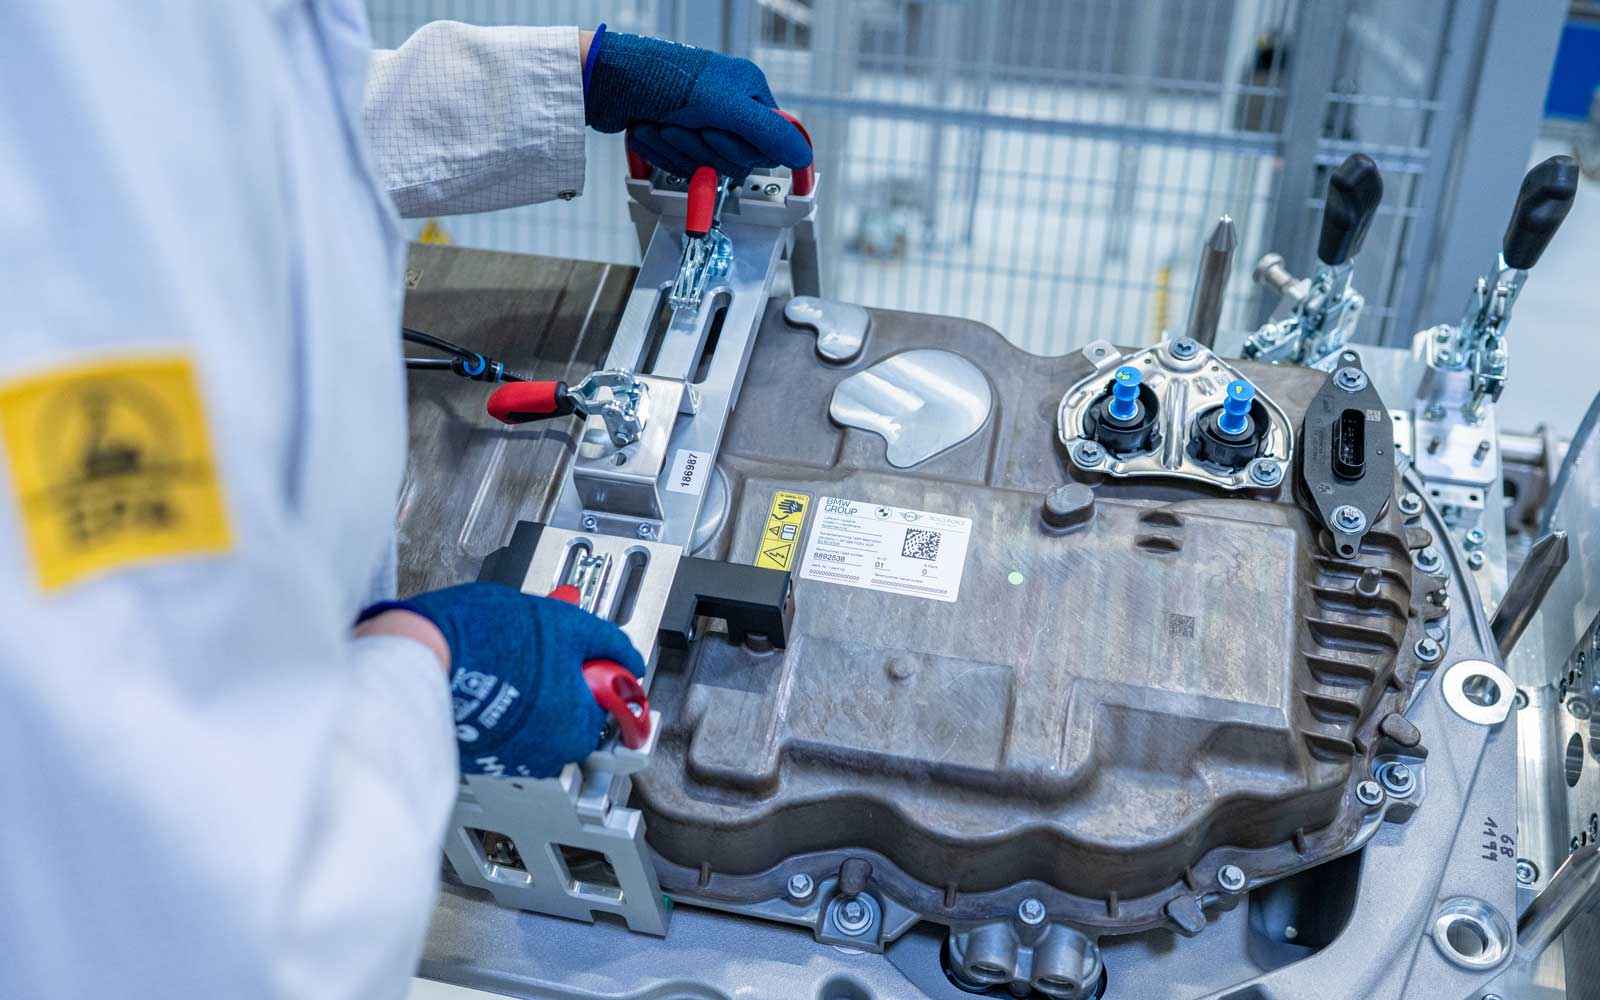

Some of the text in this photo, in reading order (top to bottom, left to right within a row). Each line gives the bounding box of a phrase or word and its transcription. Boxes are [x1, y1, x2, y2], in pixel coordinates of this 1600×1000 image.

[680, 453, 698, 488] 186987
[824, 504, 858, 515] GROUP
[826, 498, 851, 507] BMW
[1482, 817, 1498, 862] 1199
